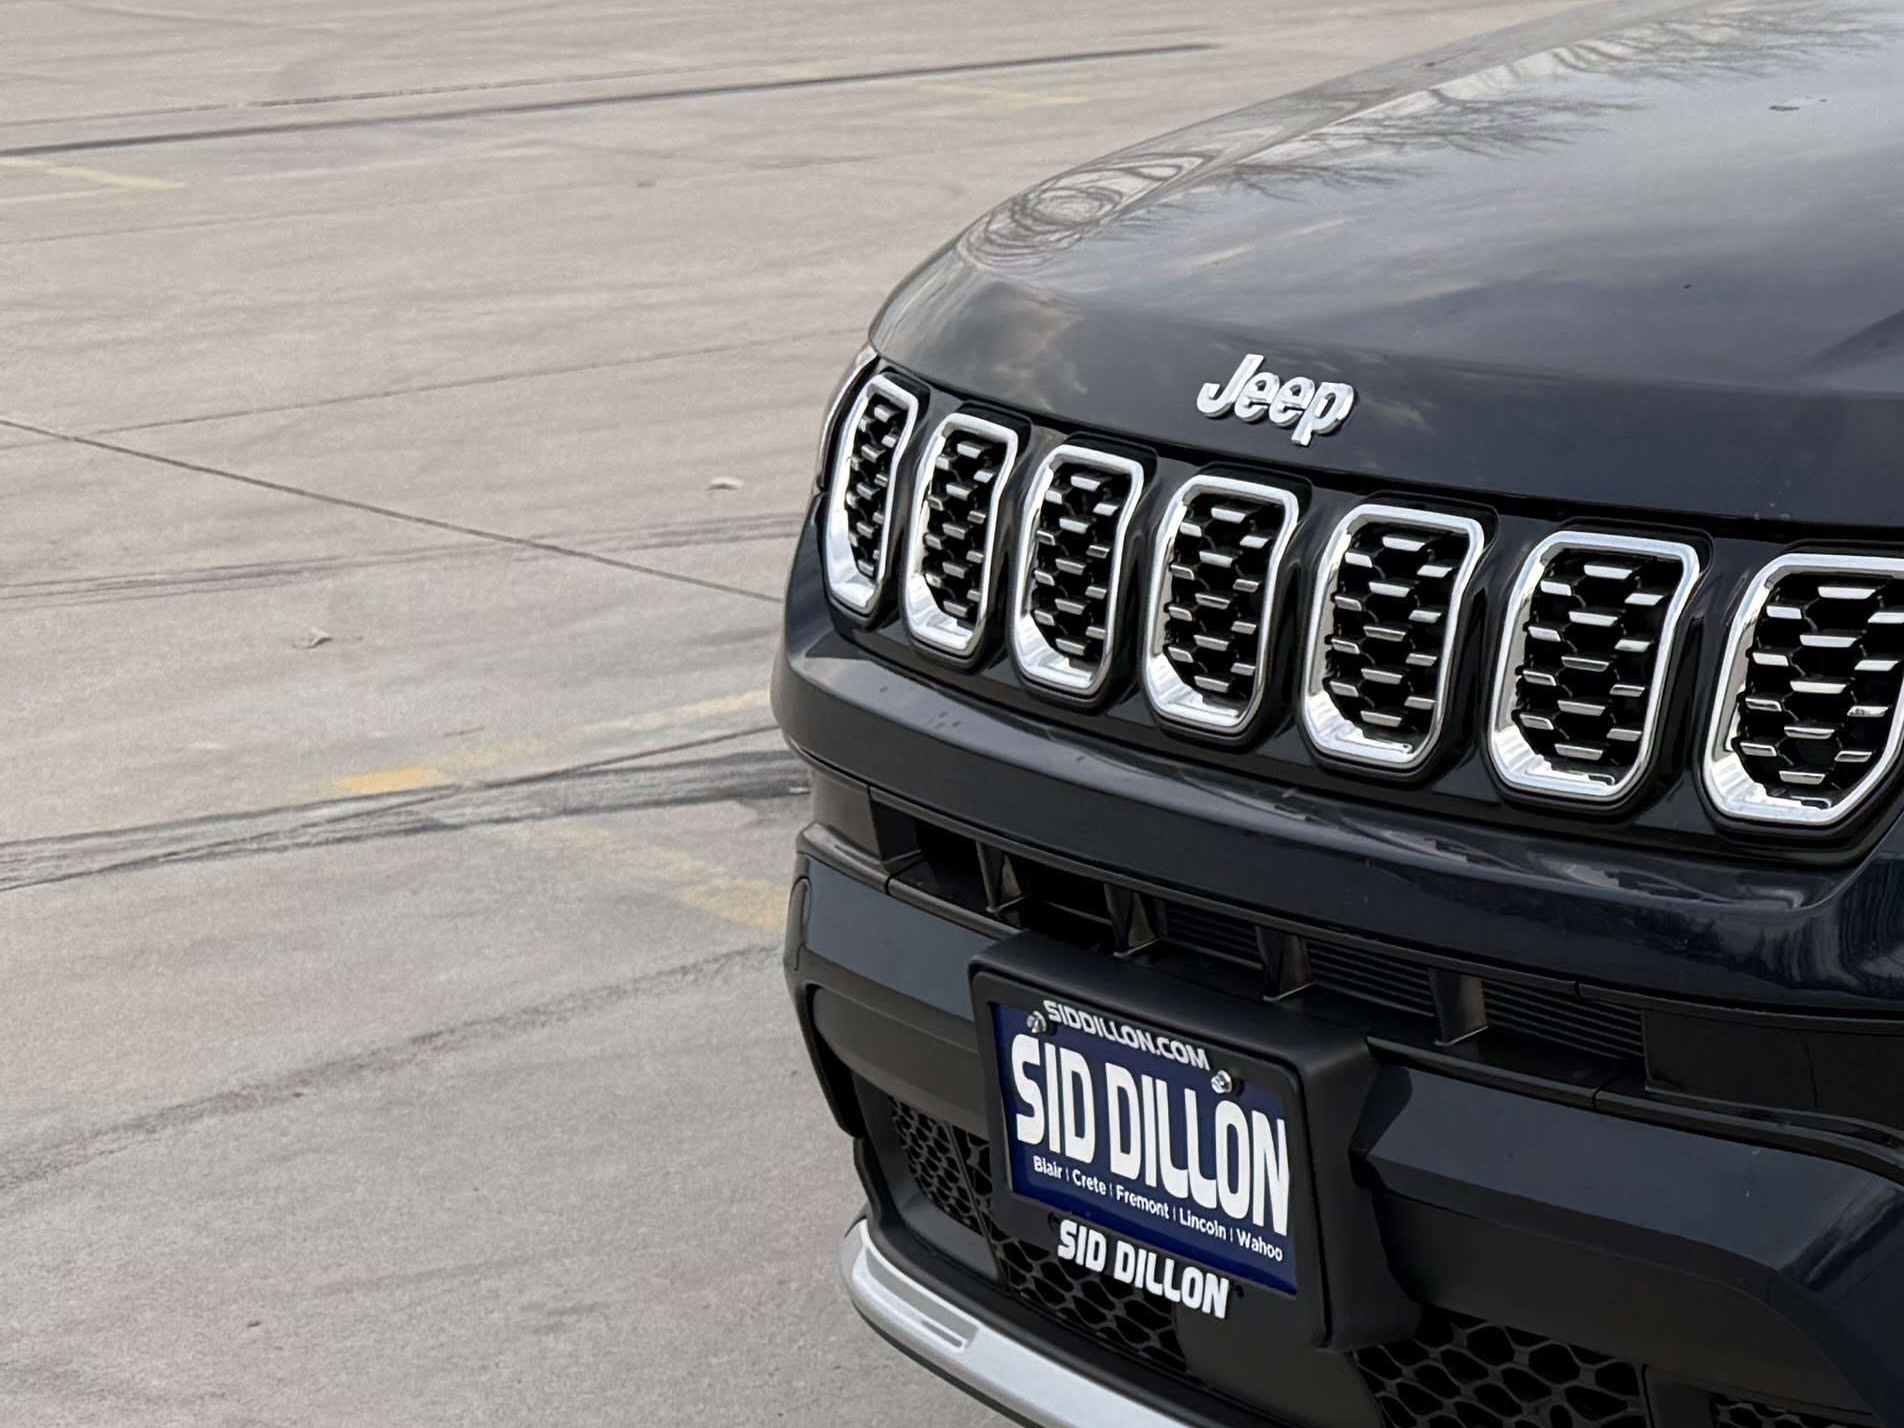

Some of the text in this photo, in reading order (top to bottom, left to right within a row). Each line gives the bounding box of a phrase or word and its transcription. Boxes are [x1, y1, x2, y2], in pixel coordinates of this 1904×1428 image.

[1196, 353, 1354, 446] Jeep
[1043, 999, 1210, 1071] SIDDILLON.COM
[1011, 1033, 1290, 1237] SID DILLON
[1033, 1155, 1284, 1262] Blair Crete Fremont Lincoln Wahoo
[1057, 1220, 1230, 1319] SID DILLON
